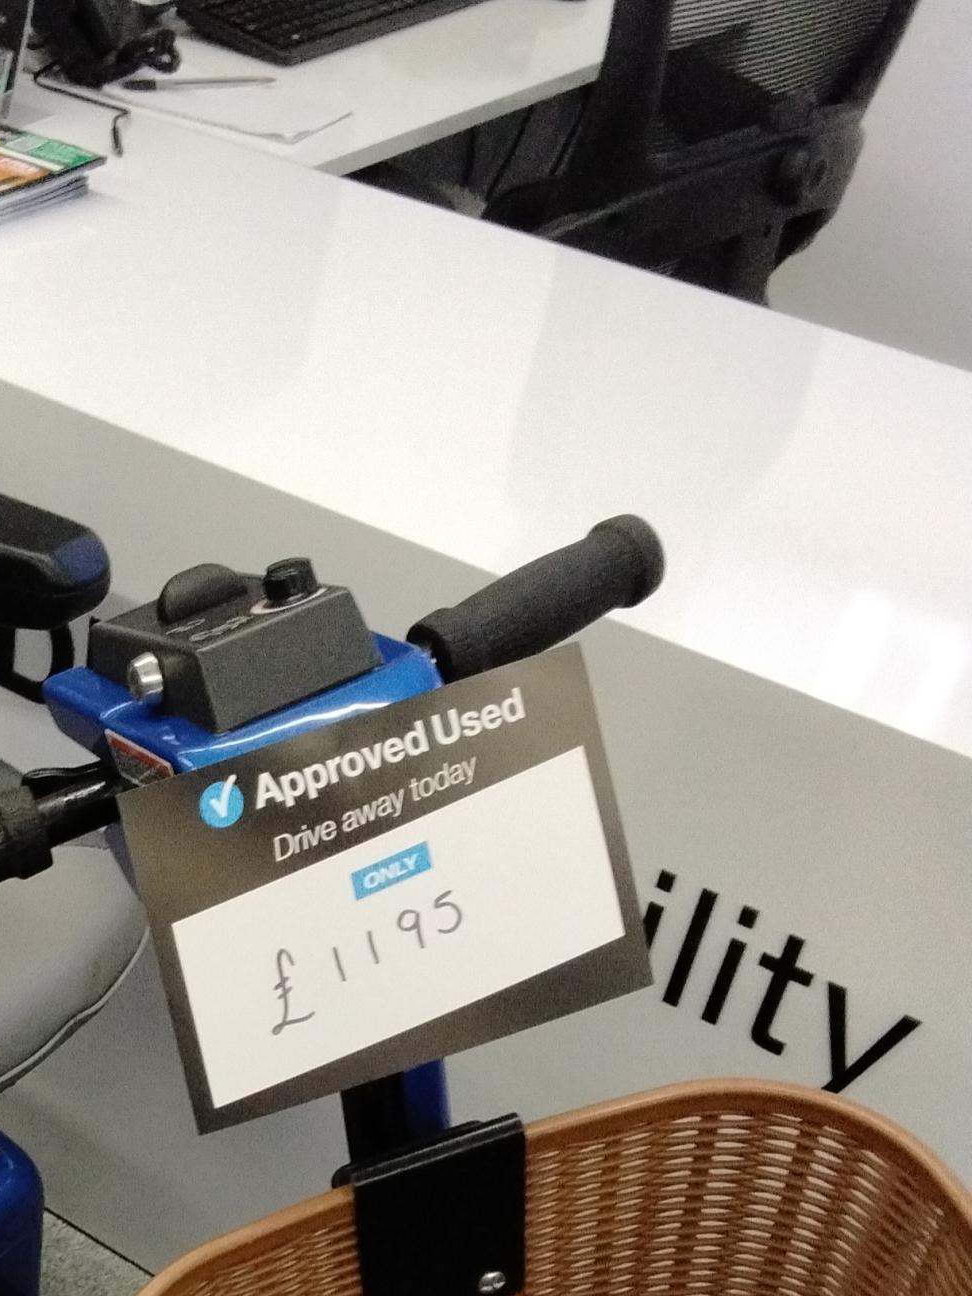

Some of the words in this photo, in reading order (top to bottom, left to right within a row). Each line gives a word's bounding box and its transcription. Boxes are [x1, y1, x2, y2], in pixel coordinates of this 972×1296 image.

[254, 719, 430, 810] Approved
[431, 686, 526, 745] Used
[273, 819, 338, 862] Drive
[341, 788, 405, 832] away
[408, 756, 477, 802] today
[362, 852, 421, 890] ONLY
[271, 889, 464, 1037] £1195
[642, 868, 923, 1094] ility
